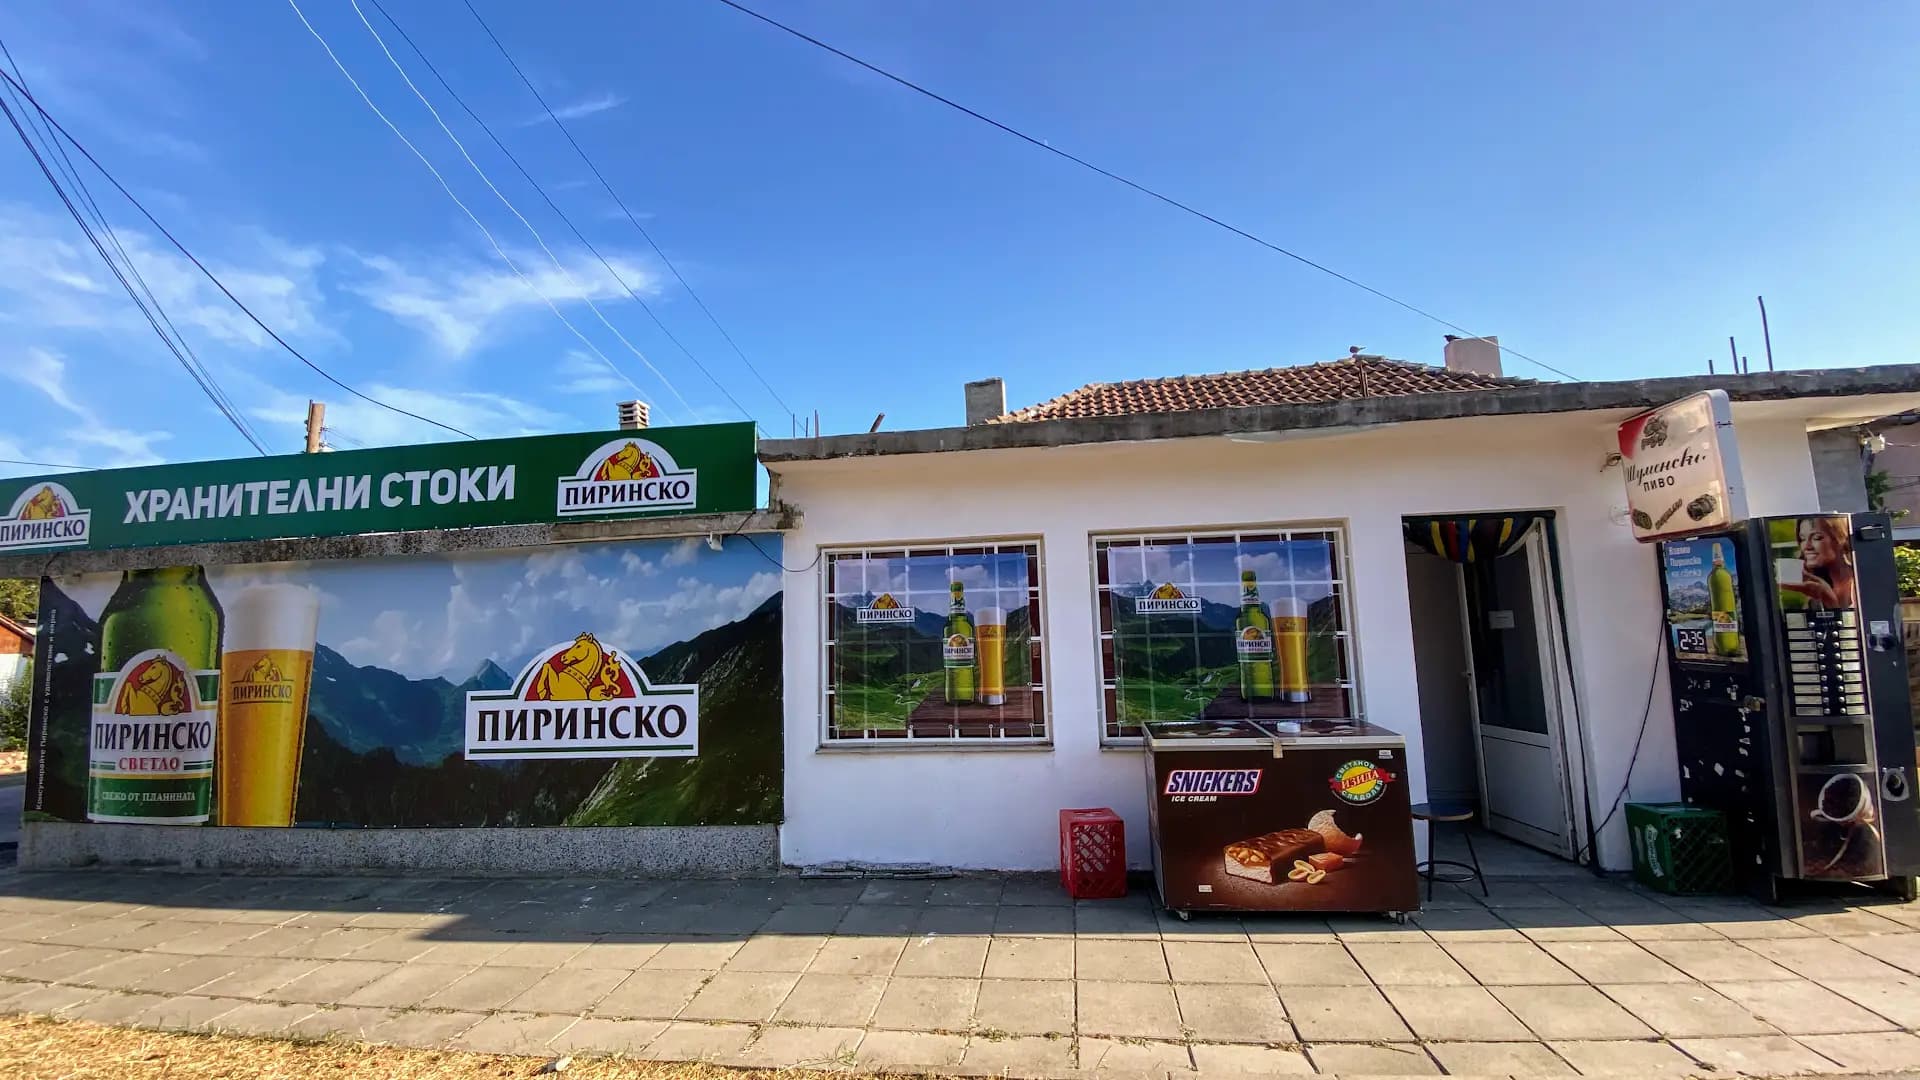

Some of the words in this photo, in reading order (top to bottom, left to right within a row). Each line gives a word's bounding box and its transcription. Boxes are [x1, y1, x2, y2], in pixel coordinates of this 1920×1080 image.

[122, 474, 371, 523] ХРАНИТЕЛНИ
[380, 464, 515, 507] СТОКИ
[565, 480, 690, 506] ПИРИНСКО
[0, 519, 85, 541] ПИРИНСКО
[859, 609, 912, 619] ПИРИНСКО
[1139, 600, 1198, 610] ПИРИНСКО
[233, 684, 293, 699] ПИРИНСКО
[39, 706, 50, 747] Пиринско
[477, 704, 688, 742] ПИРИНСКО
[94, 720, 211, 750] ПИРИНСКО
[118, 757, 180, 771] СВЕТЛО
[1336, 761, 1375, 778] СМЕТАНОВ
[1168, 771, 1259, 793] SNICKERS
[1341, 769, 1380, 790] ИЗИДА
[128, 792, 140, 801] ОТ
[142, 791, 196, 802] ПЛАНИНАТА
[1341, 780, 1383, 801] СЛАДОЛЕД
